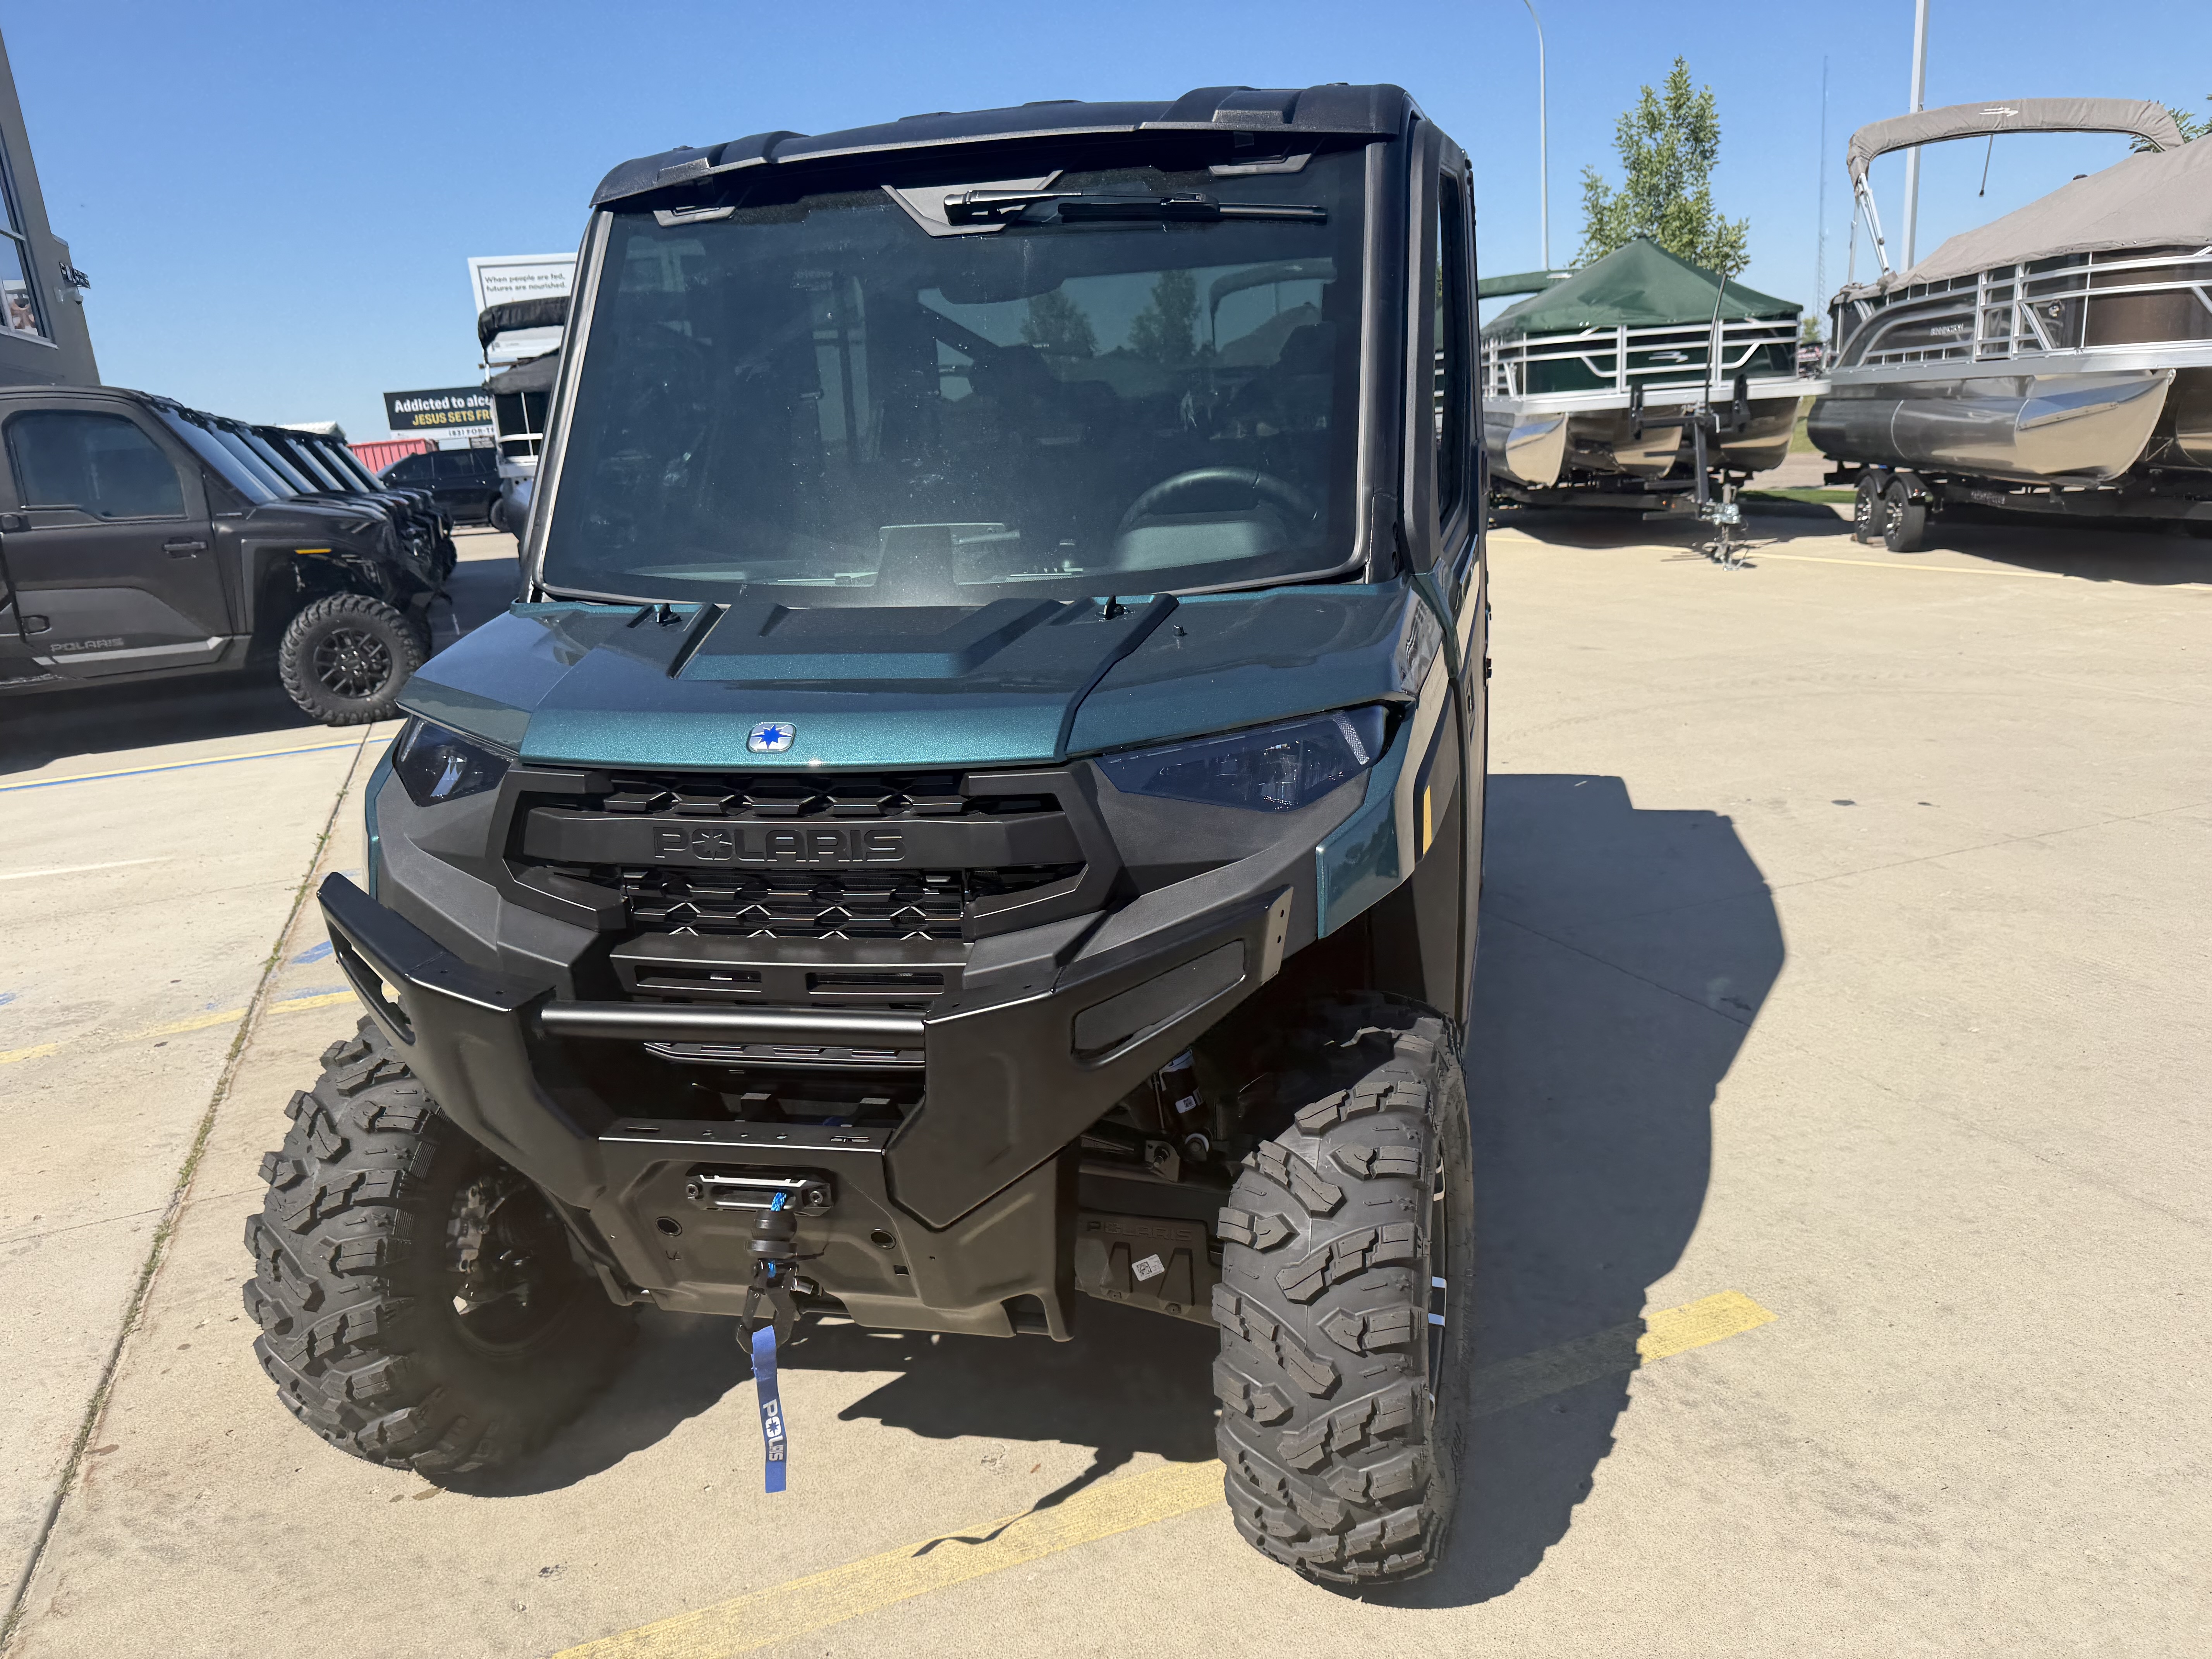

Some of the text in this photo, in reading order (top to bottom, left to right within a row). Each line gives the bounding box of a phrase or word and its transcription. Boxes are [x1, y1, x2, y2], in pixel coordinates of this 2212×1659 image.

[509, 274, 535, 283] people
[395, 396, 450, 413] Addicted
[451, 396, 465, 409] to
[412, 412, 447, 426] JESUS
[448, 410, 475, 423] SETS
[50, 638, 124, 652] POLARIS
[653, 826, 907, 862] POLARIS
[1087, 1221, 1192, 1241] POLARIS
